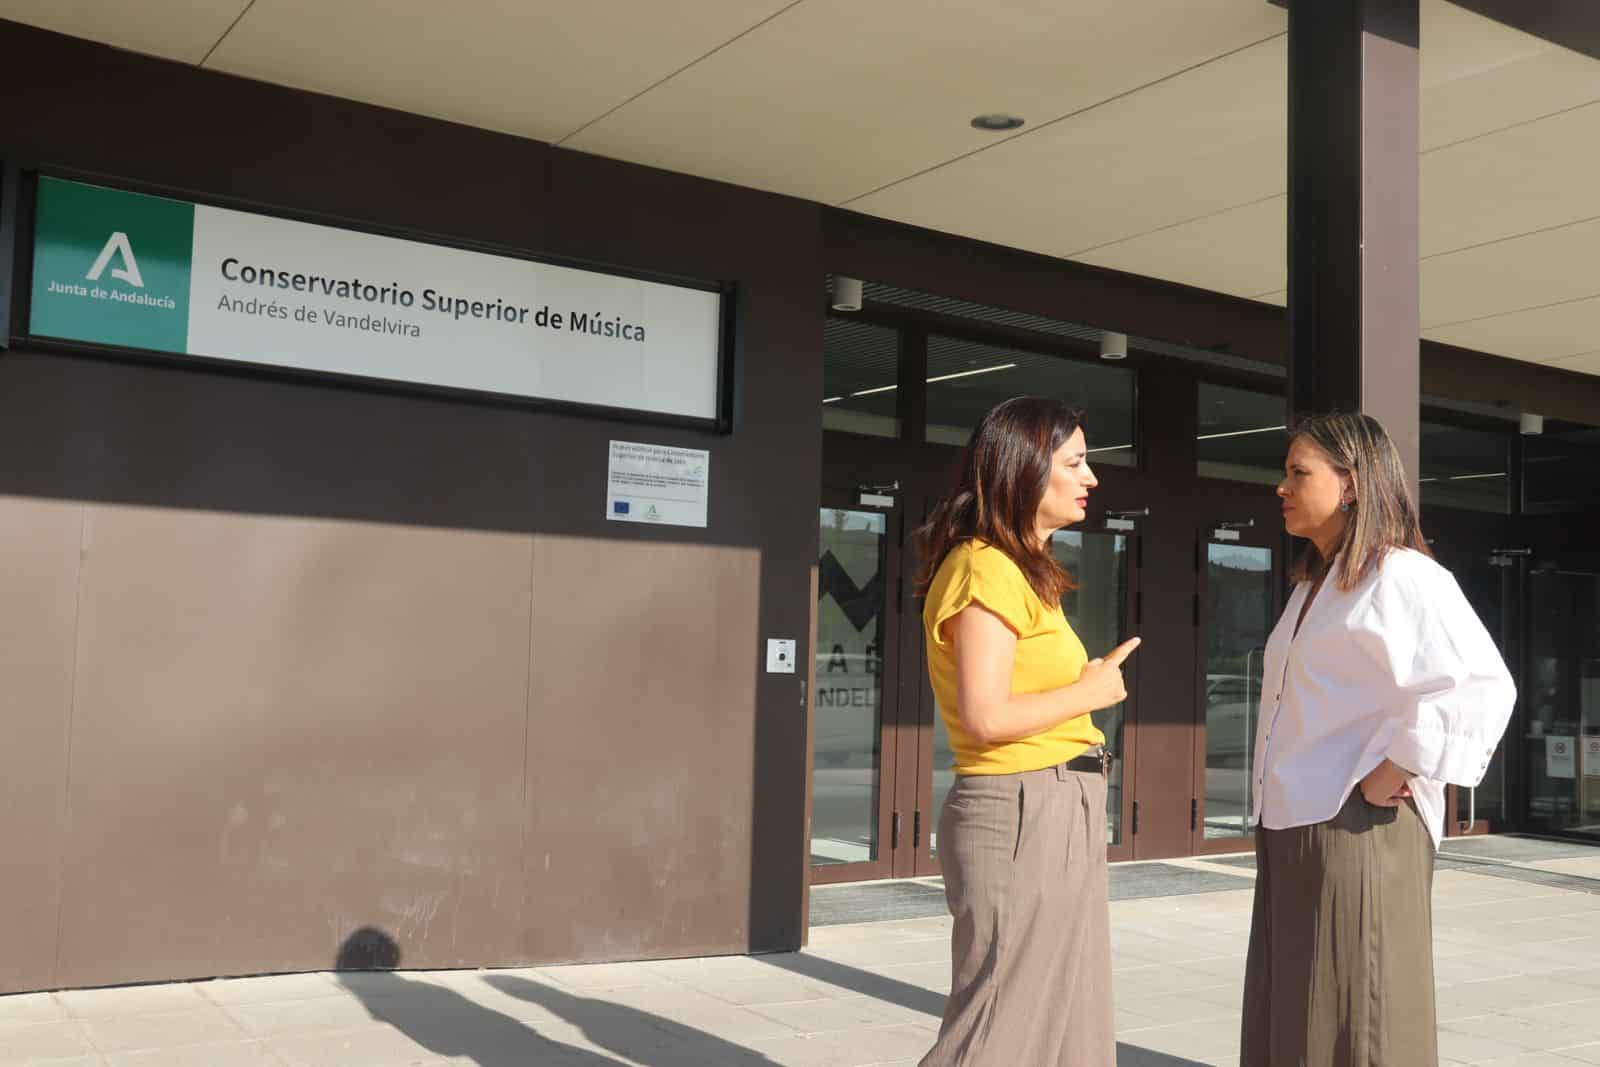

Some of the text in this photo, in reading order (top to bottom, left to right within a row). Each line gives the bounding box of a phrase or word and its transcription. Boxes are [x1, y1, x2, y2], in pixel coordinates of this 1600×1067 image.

[47, 280, 176, 310] Junta de Andalucía
[216, 294, 421, 338] Andrés de Vandelvira
[220, 257, 646, 342] Conservatorio Superior de Música
